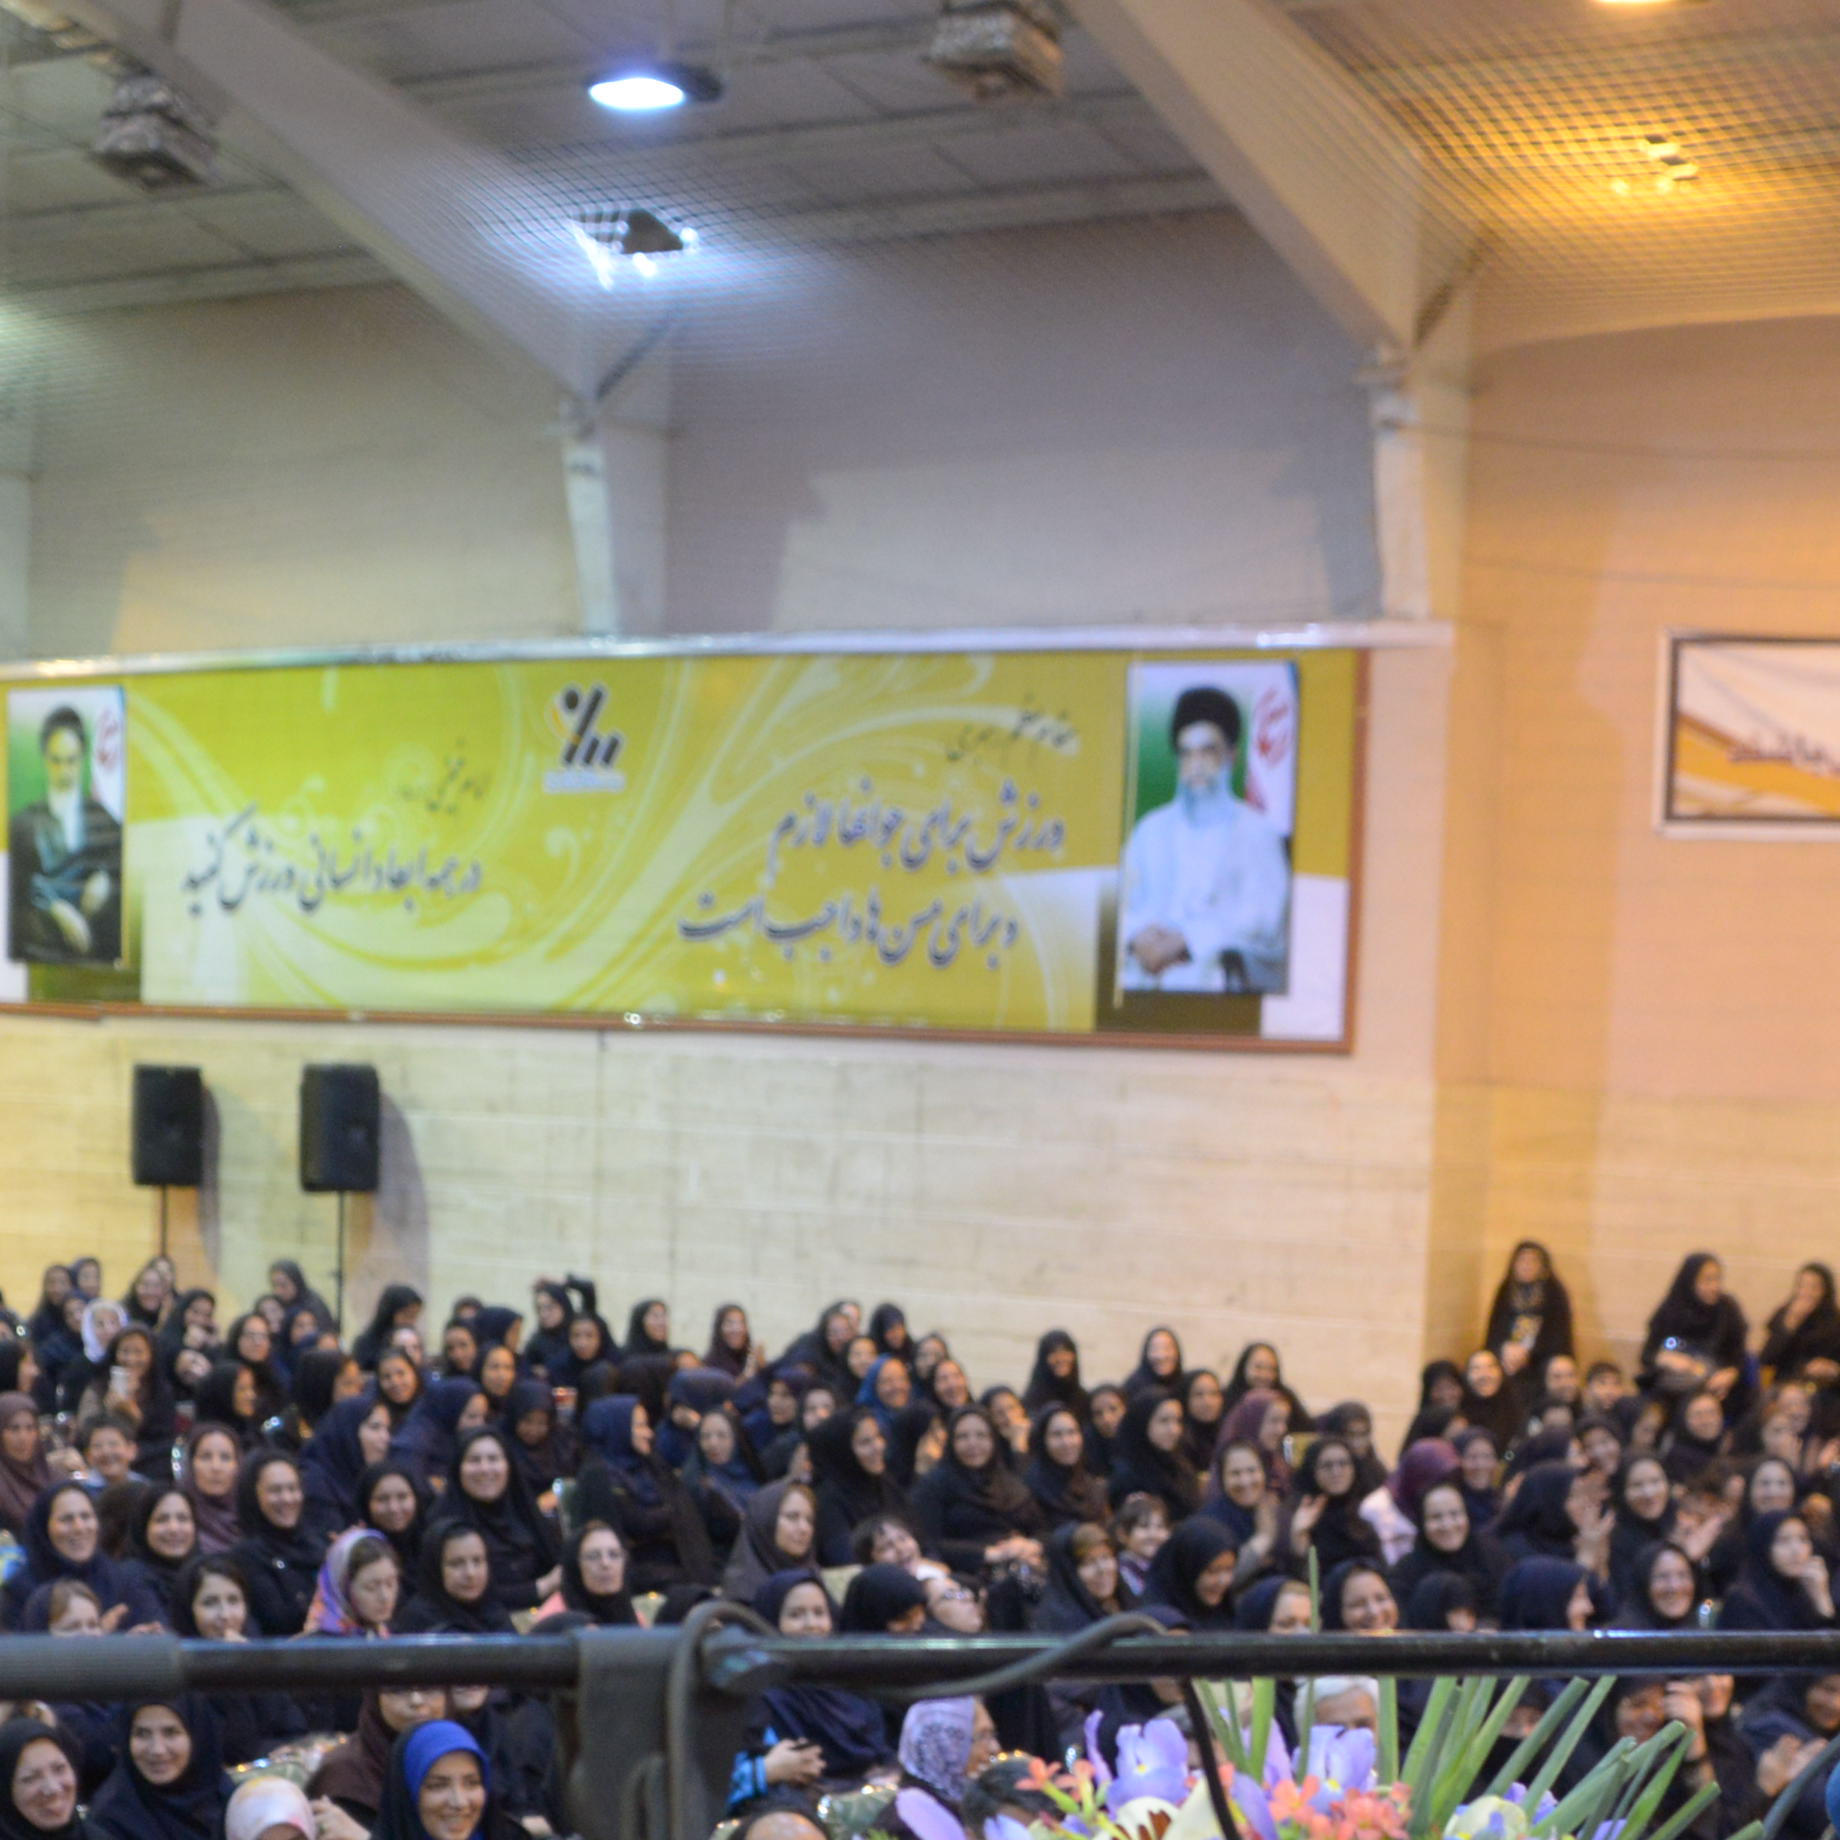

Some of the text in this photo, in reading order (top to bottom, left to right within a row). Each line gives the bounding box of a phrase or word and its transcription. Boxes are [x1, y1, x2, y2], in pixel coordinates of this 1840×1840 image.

[900, 800, 971, 875] برای
[965, 778, 1065, 871] ورزش
[217, 828, 295, 914] ورزش
[678, 891, 765, 940] است
